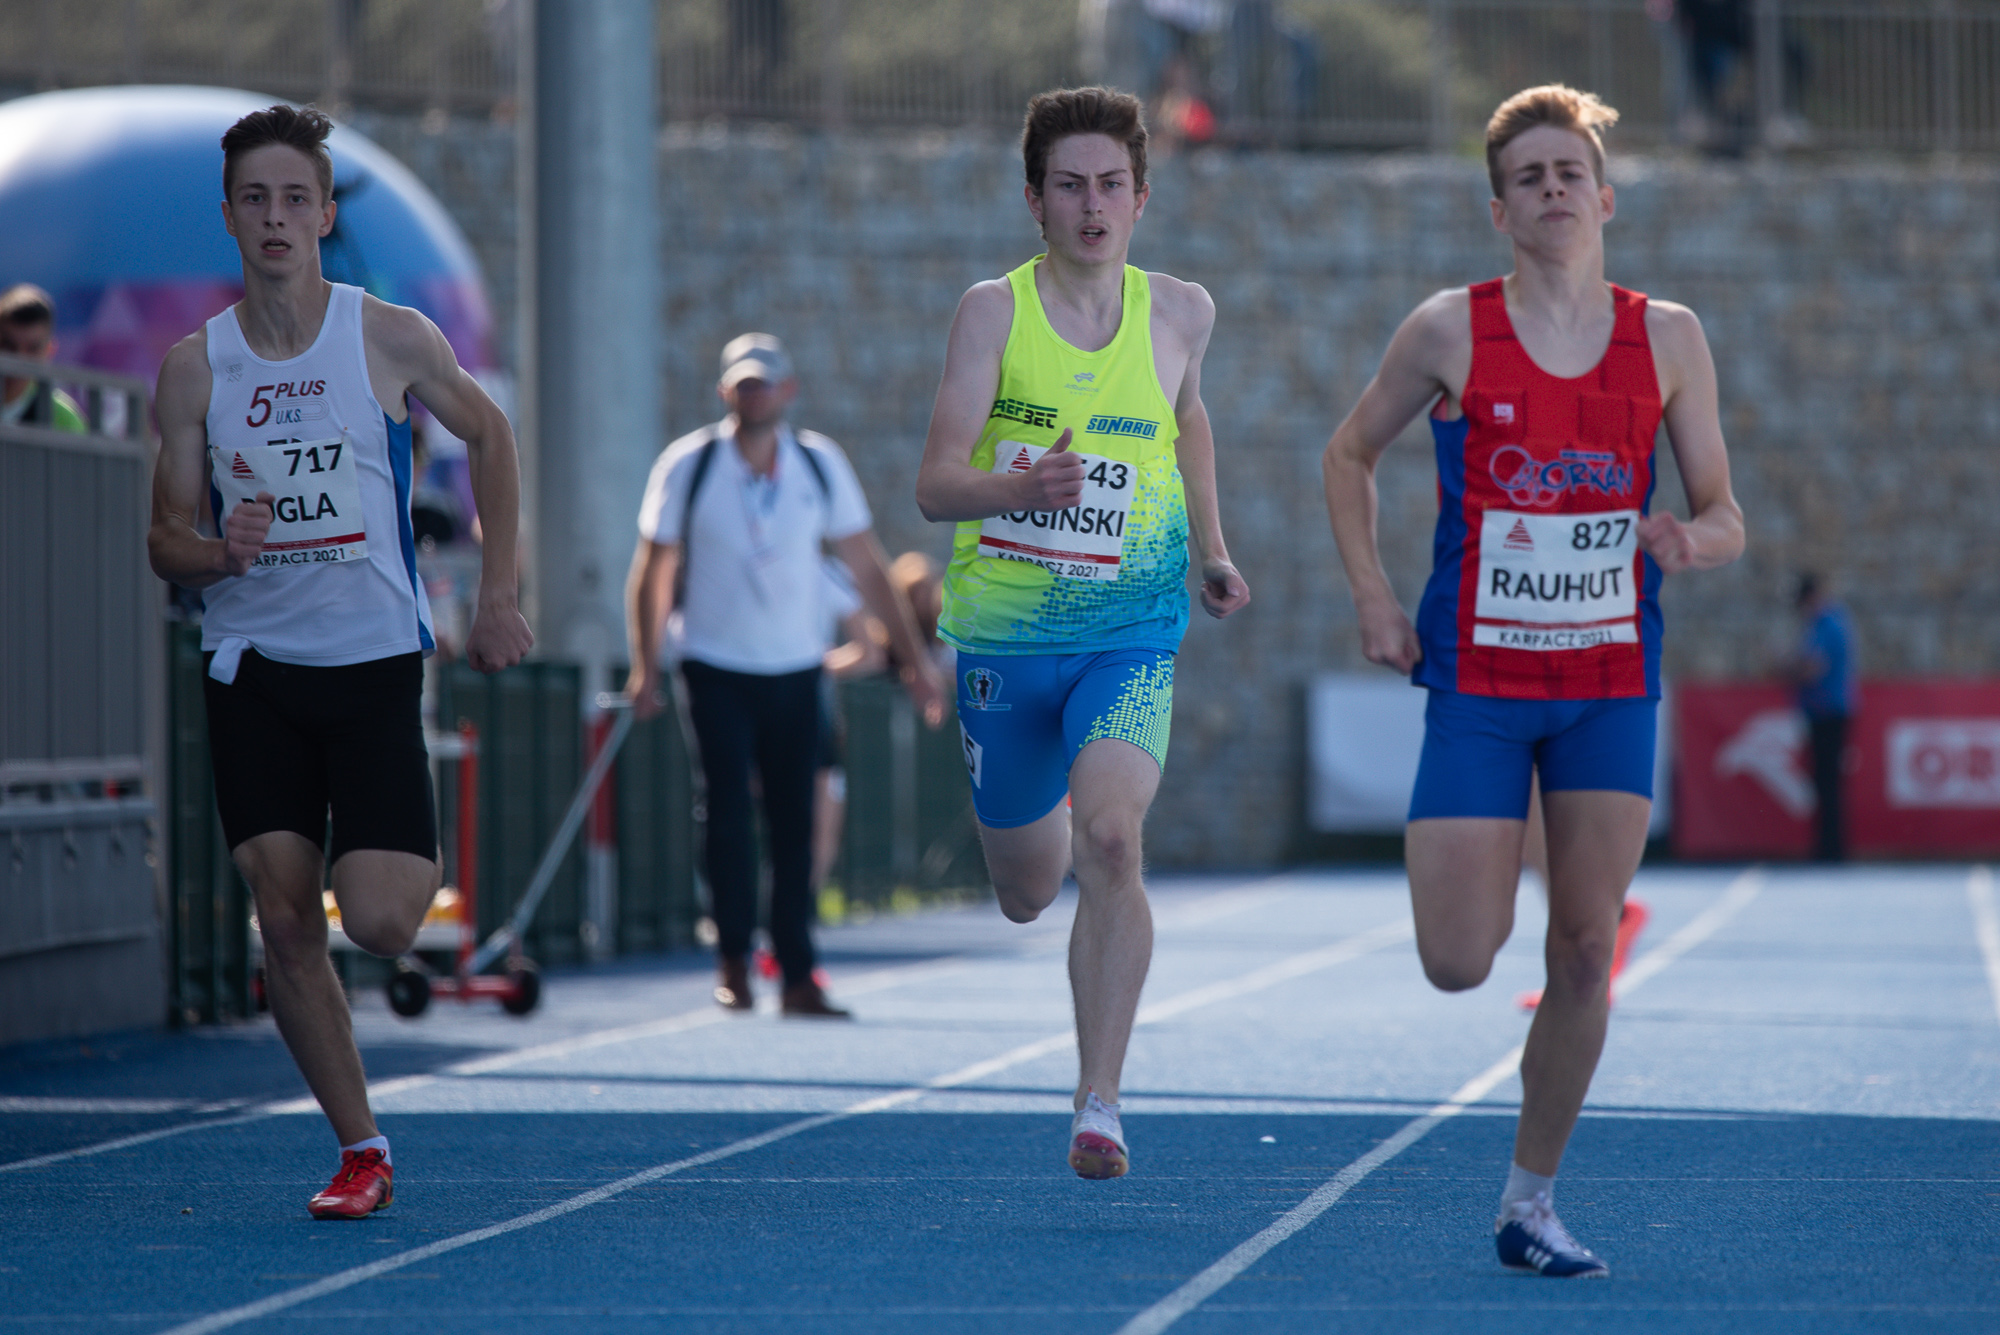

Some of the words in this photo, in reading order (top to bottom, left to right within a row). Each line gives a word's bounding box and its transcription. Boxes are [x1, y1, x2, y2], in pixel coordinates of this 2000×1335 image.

[246, 384, 275, 428] 5
[274, 379, 327, 399] PLUS
[1084, 414, 1160, 440] SONAROL
[282, 443, 343, 477] 717
[1081, 458, 1128, 490] 43
[240, 492, 339, 525] GLA
[1572, 518, 1632, 551] 827
[312, 547, 346, 562] 2021
[1067, 564, 1100, 578] 2021
[1491, 566, 1624, 603] RAUHUT
[1499, 631, 1576, 648] KARPACZ
